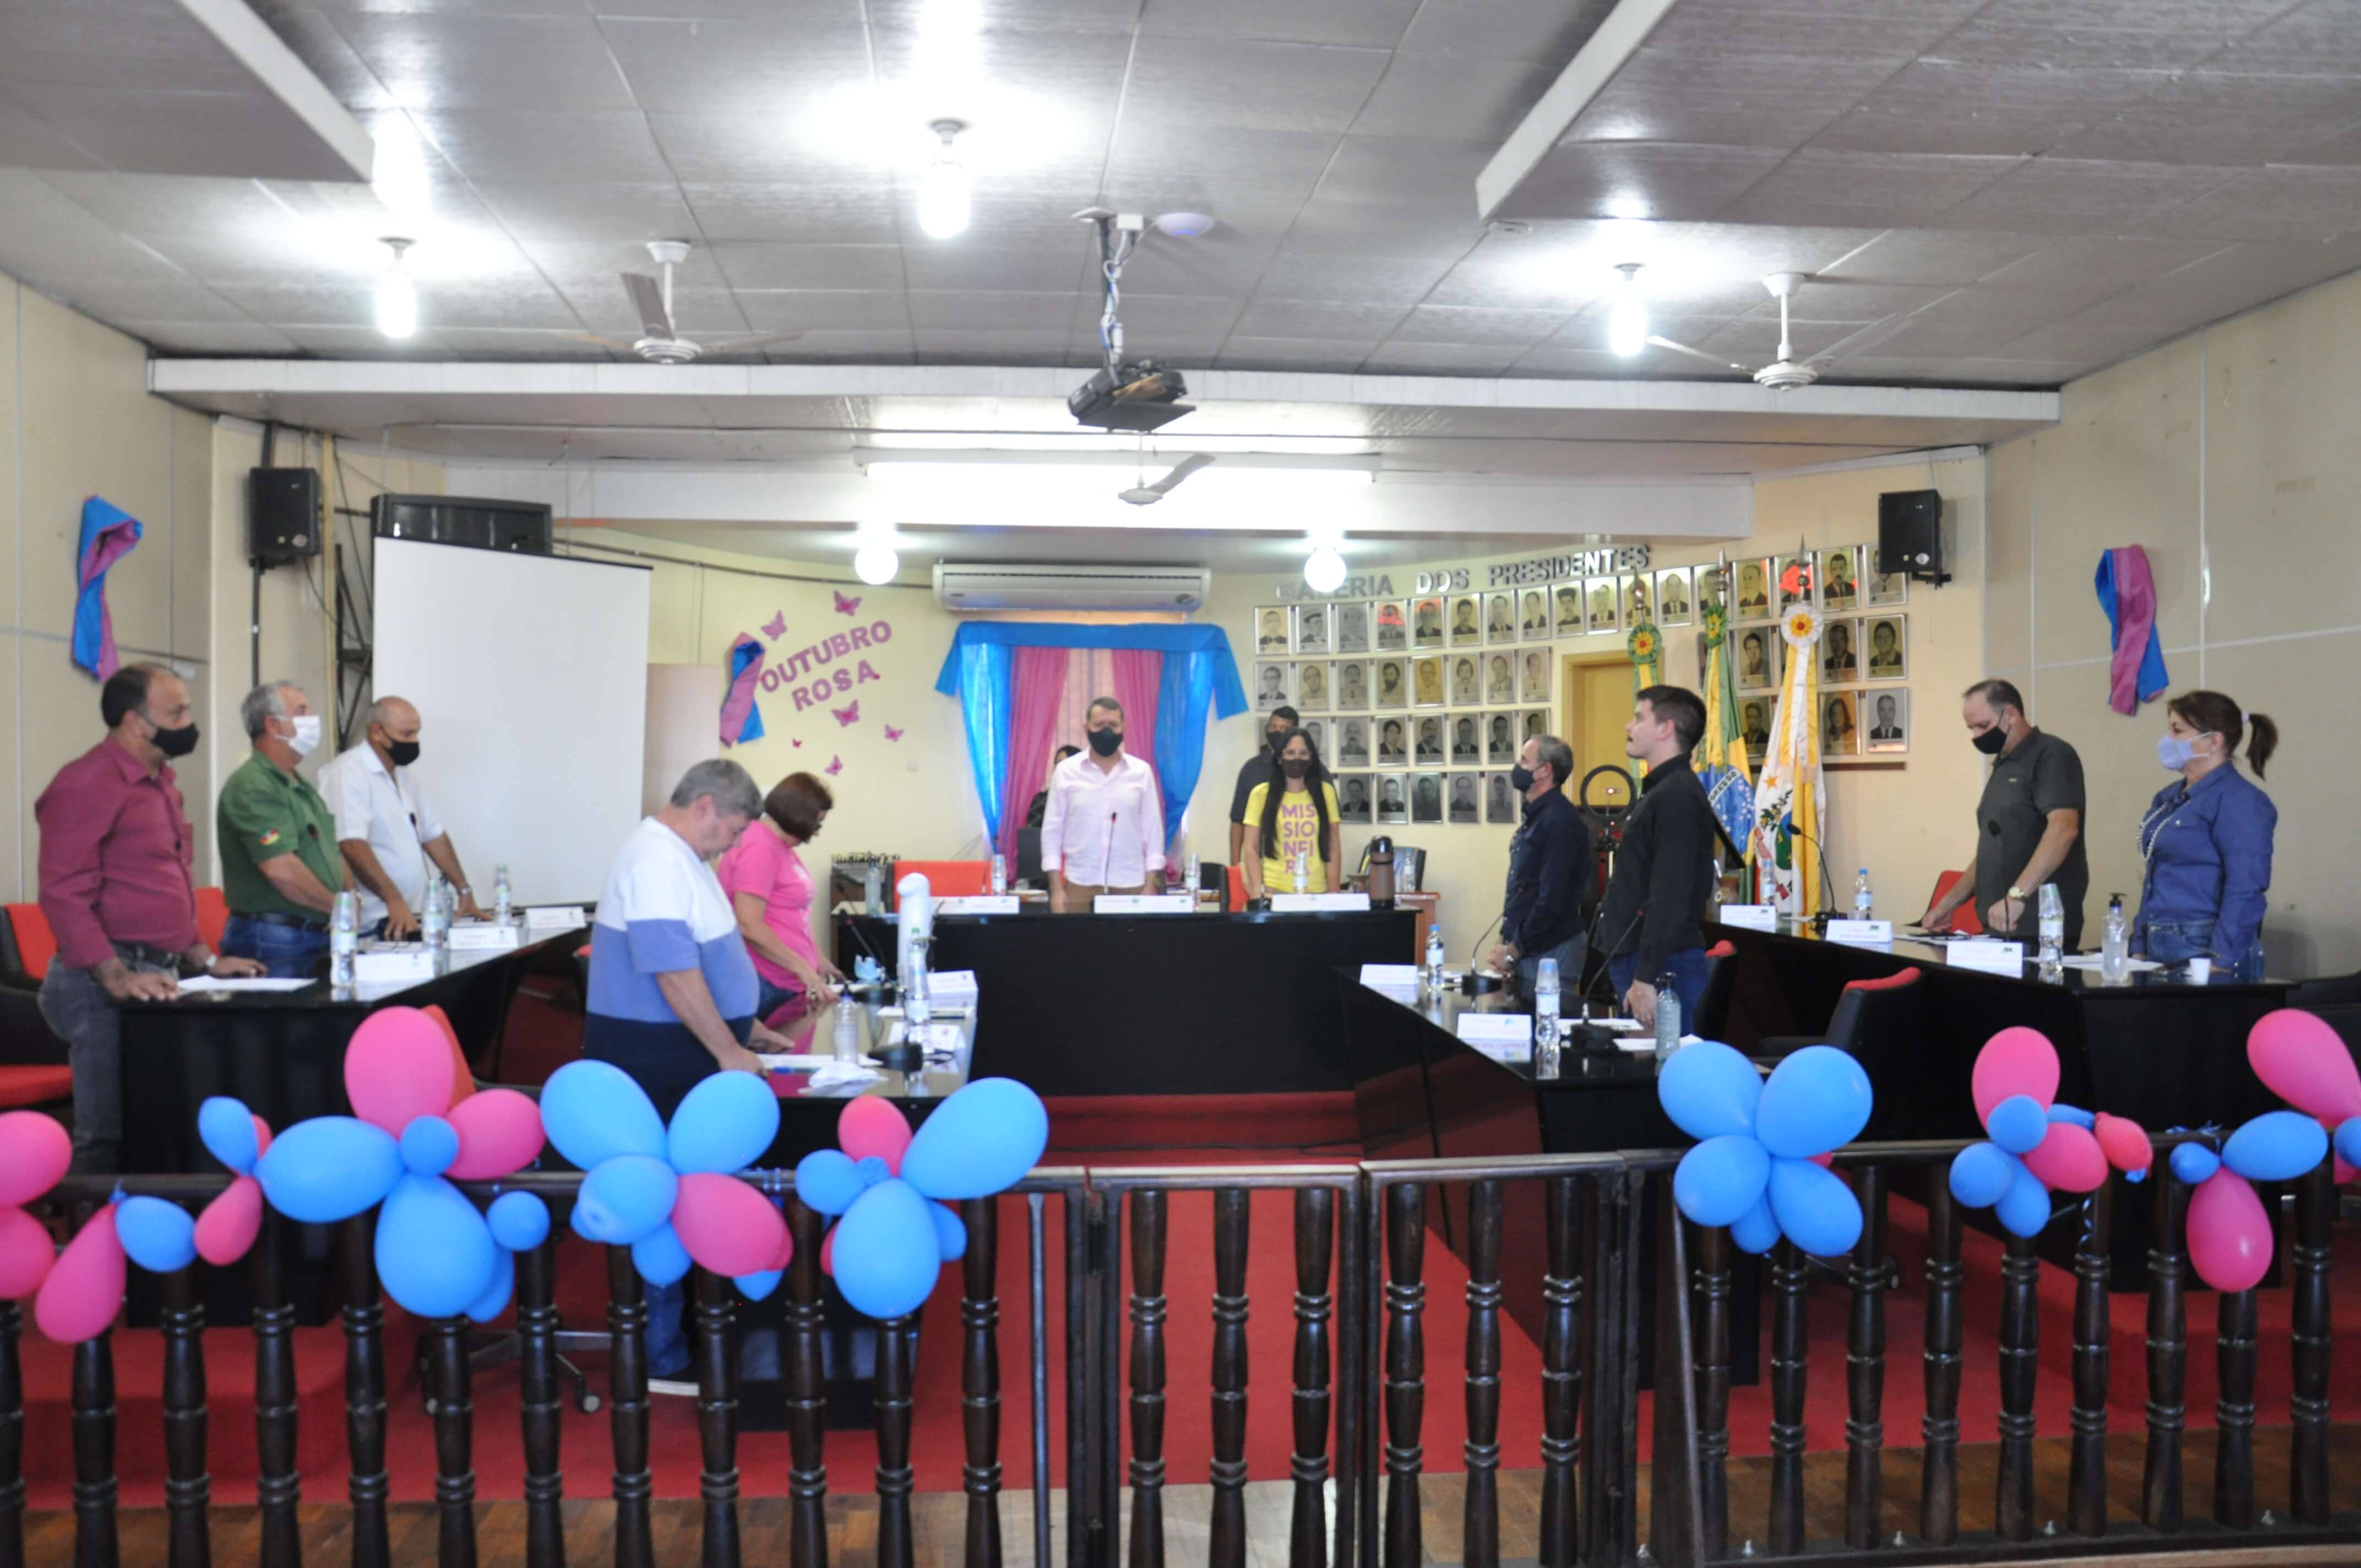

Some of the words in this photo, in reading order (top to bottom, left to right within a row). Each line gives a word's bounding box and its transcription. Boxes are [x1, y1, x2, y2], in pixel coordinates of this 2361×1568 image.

[1276, 574, 1394, 601] GAERIA
[1416, 568, 1471, 595] DOS
[1488, 545, 1651, 587] PRESIDENTES
[761, 620, 892, 693] OUTUBRO
[791, 659, 875, 712] ROSA
[1282, 804, 1317, 818] MIS
[1283, 821, 1315, 837] SIO
